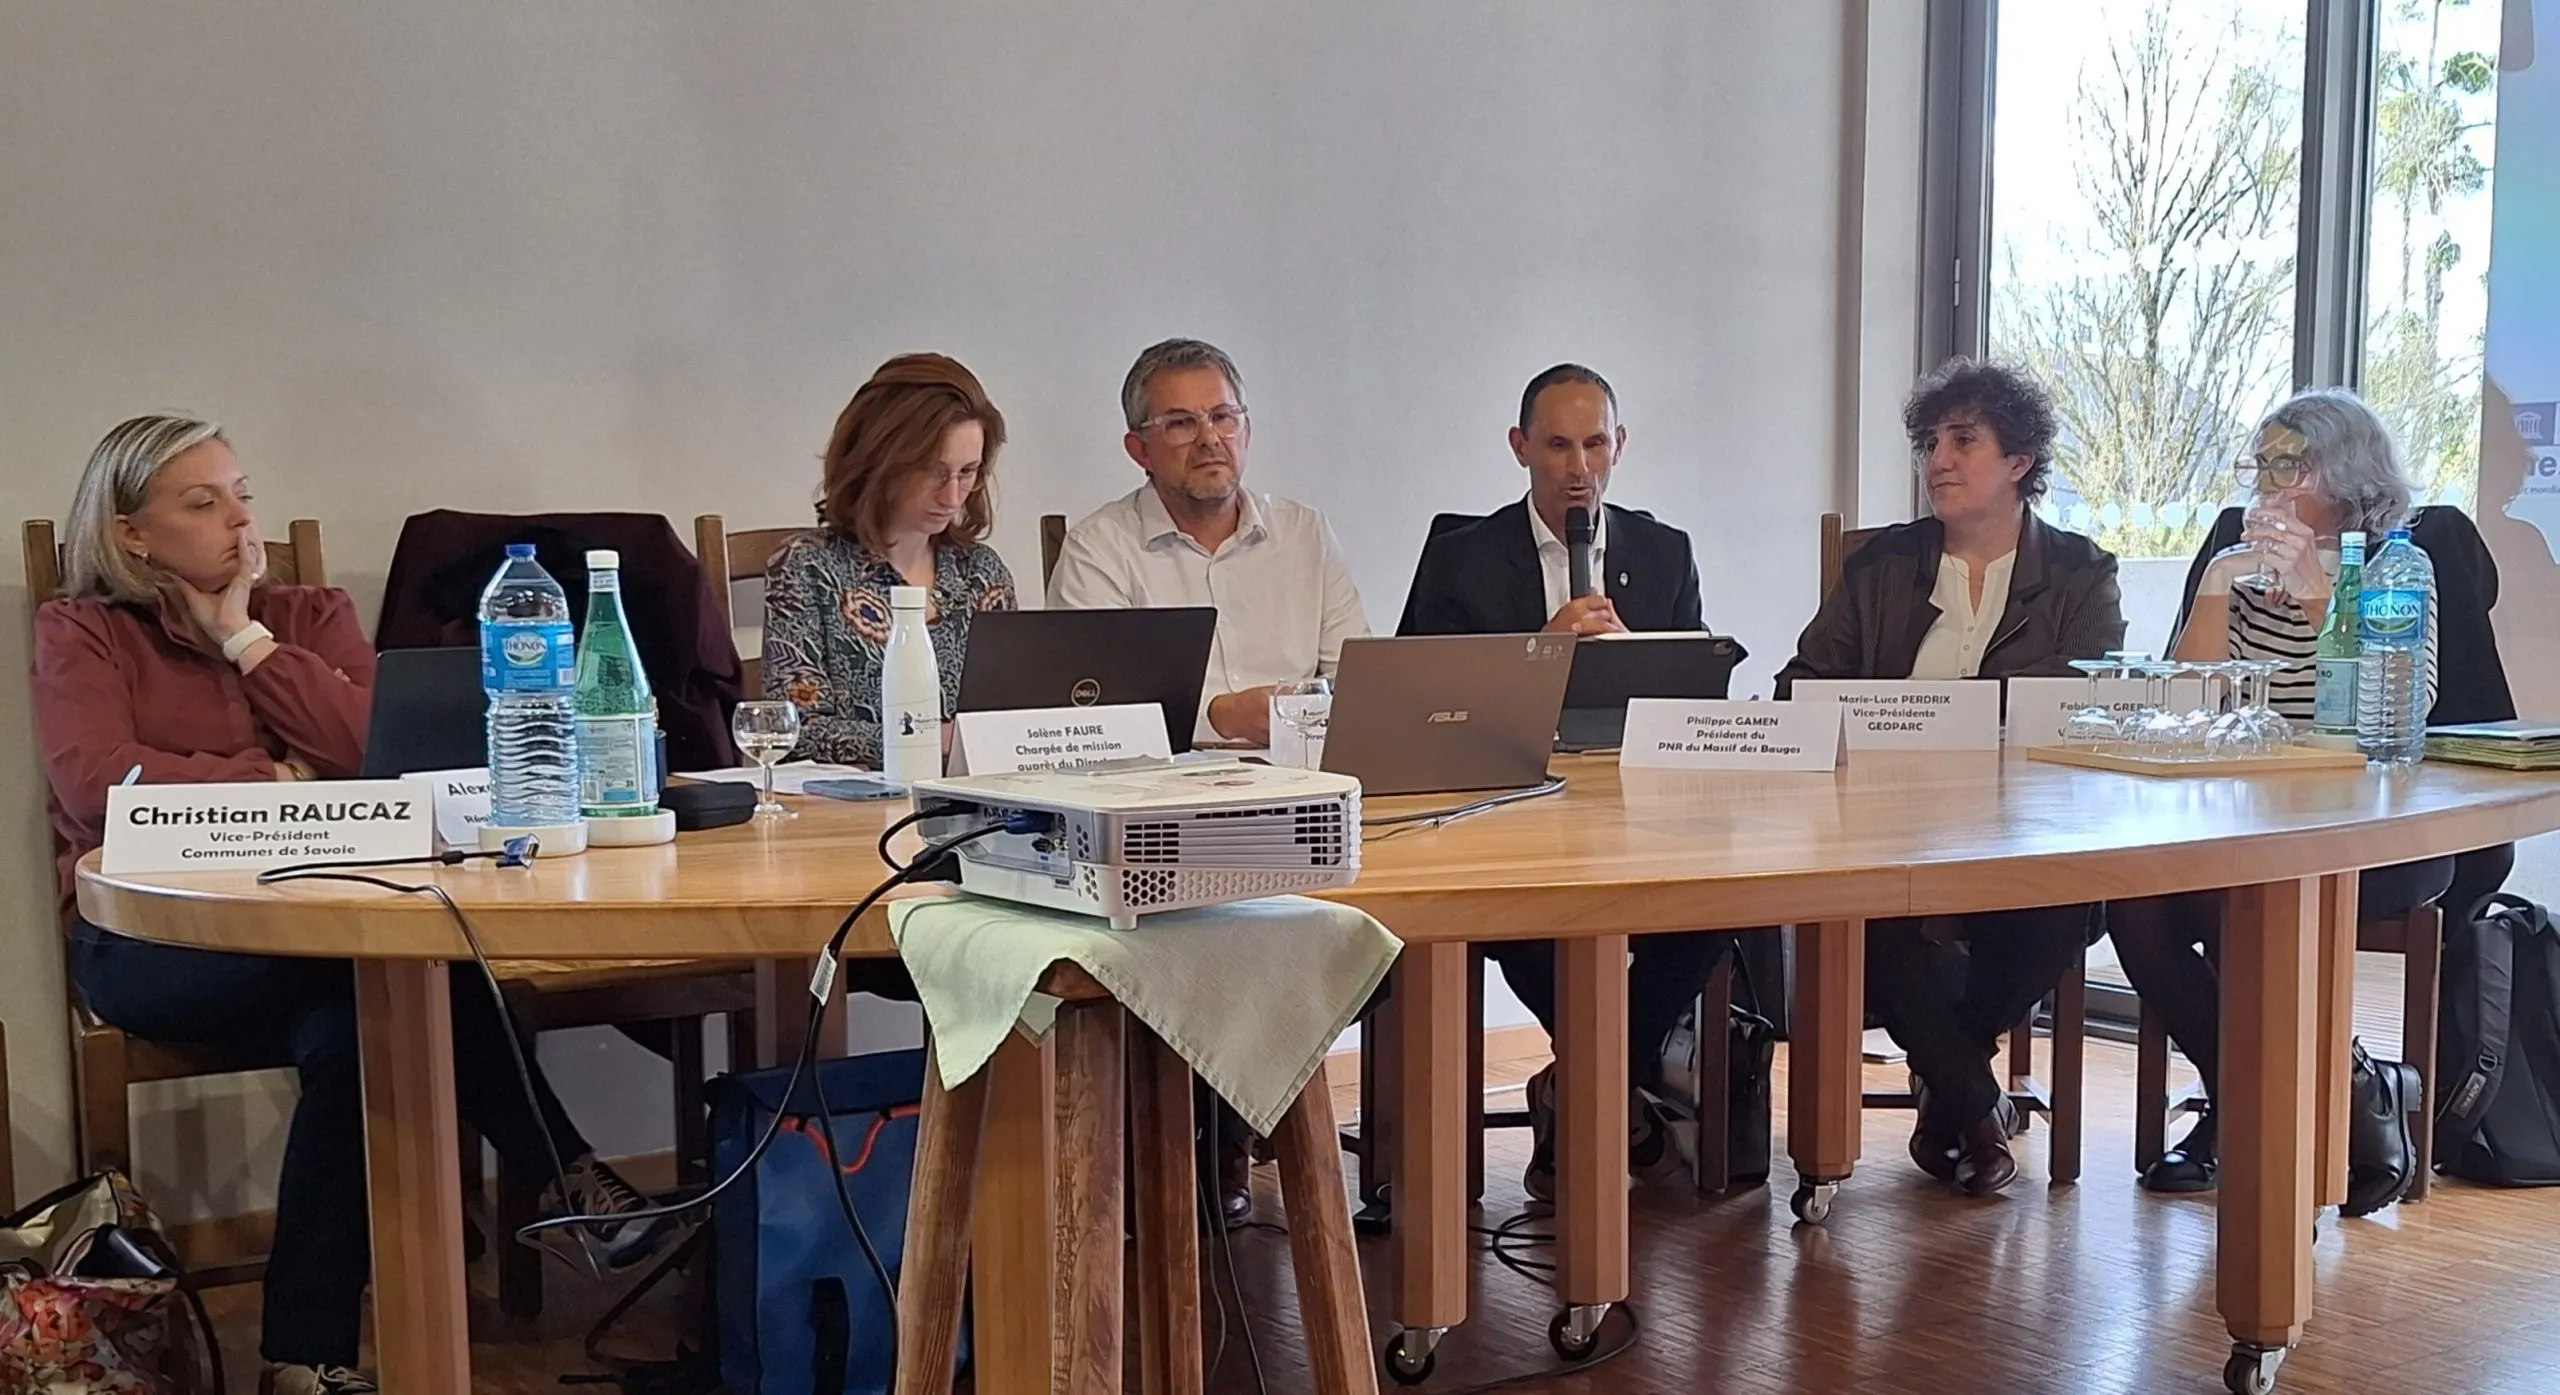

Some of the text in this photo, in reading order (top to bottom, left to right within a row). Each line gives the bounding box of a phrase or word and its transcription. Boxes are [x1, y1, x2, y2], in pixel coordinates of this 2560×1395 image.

[2366, 603, 2419, 616] THONON
[1075, 689, 1096, 698] DELL
[1839, 695, 1951, 705] Marie-Luce PERDRIX
[1427, 711, 1469, 723] ASUS
[1853, 709, 1936, 718] Vice-Présidente
[1687, 716, 1779, 726] Philippe GAMEN
[1867, 722, 1923, 731] GEOPARC
[1065, 725, 1104, 736] FAURE
[1696, 730, 1765, 740] Président du
[1015, 741, 1122, 756] Chargée de mission
[1658, 742, 1801, 755] PNR du Massif des Bauges
[129, 801, 411, 826] Christian RAUCAZ
[210, 830, 331, 842] Vice-Président
[181, 845, 357, 859] Communes de Savoie
